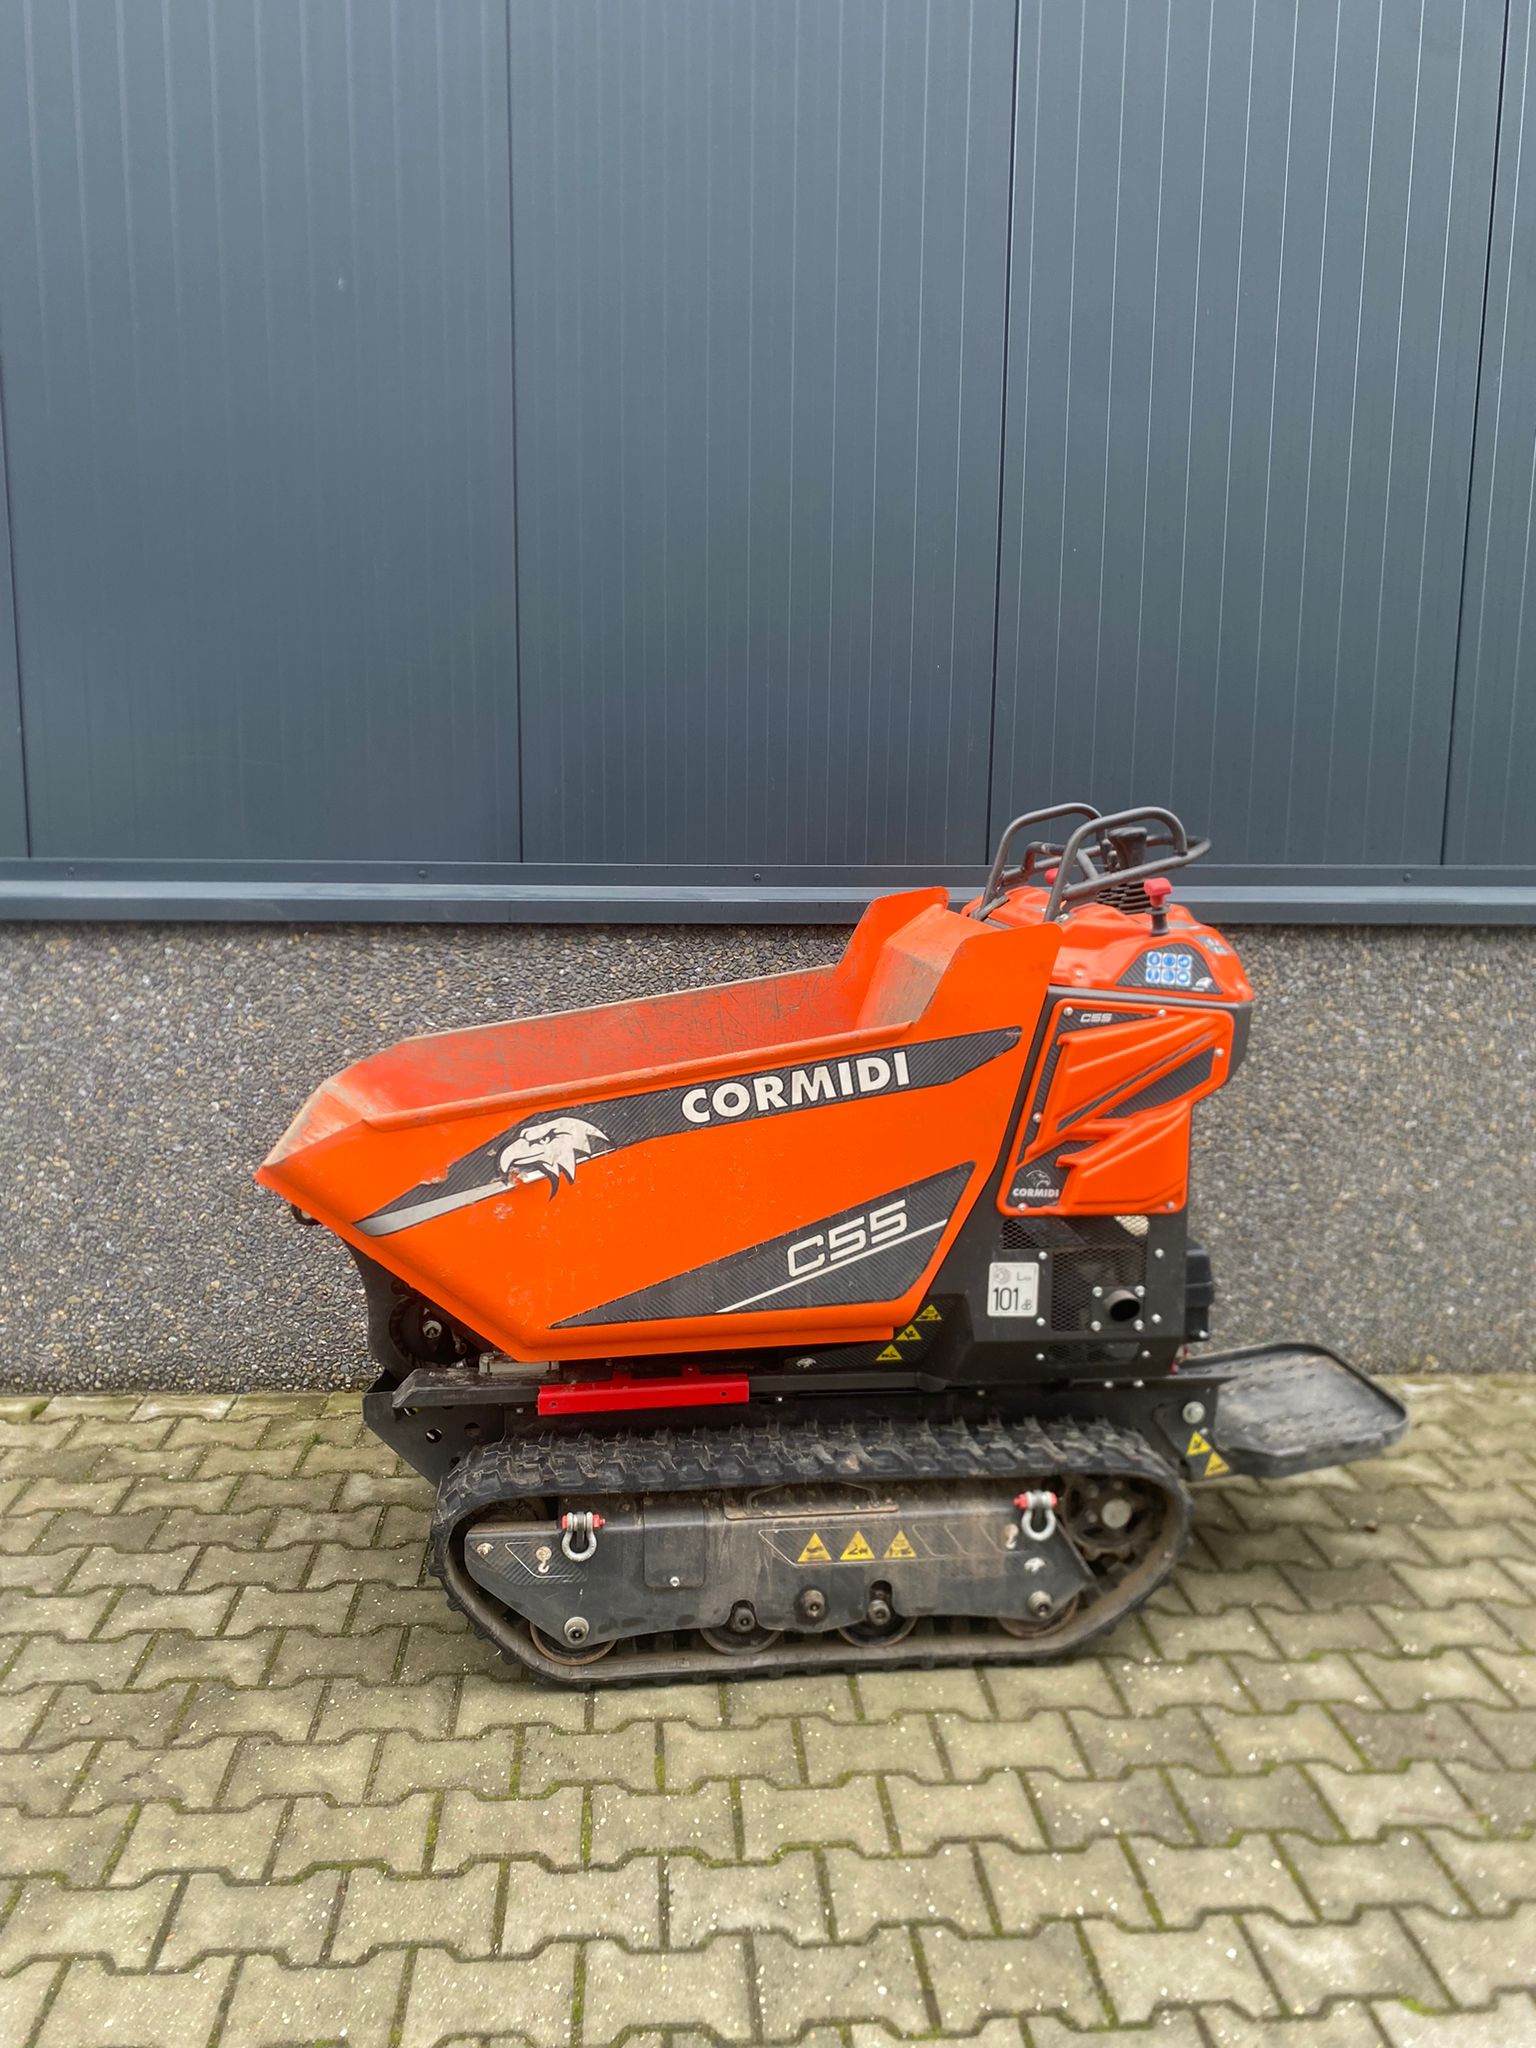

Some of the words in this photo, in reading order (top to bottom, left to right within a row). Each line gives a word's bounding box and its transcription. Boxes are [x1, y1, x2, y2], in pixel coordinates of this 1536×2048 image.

[682, 1051, 910, 1123] CORMIDI
[1012, 1188, 1060, 1197] CORMIDI
[788, 1199, 908, 1277] C55
[993, 1287, 1019, 1311] 101
